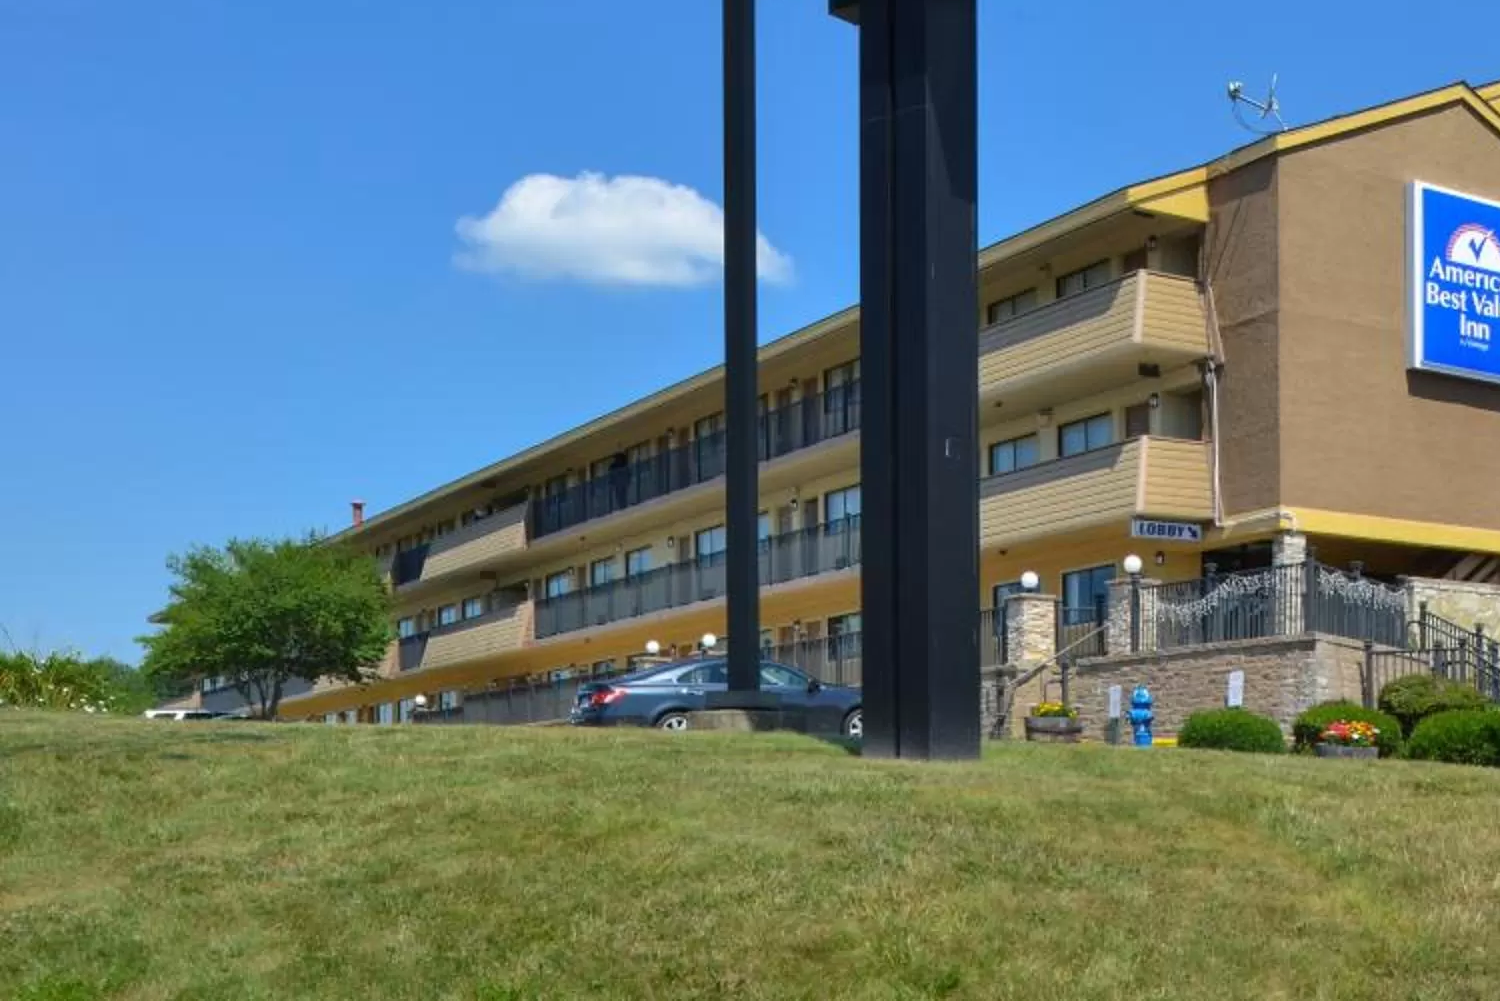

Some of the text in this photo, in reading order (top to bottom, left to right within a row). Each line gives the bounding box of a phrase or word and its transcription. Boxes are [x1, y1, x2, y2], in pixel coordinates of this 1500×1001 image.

[1426, 282, 1467, 312] Best
[1459, 314, 1490, 340] Inn
[1139, 522, 1184, 537] LOBBY
